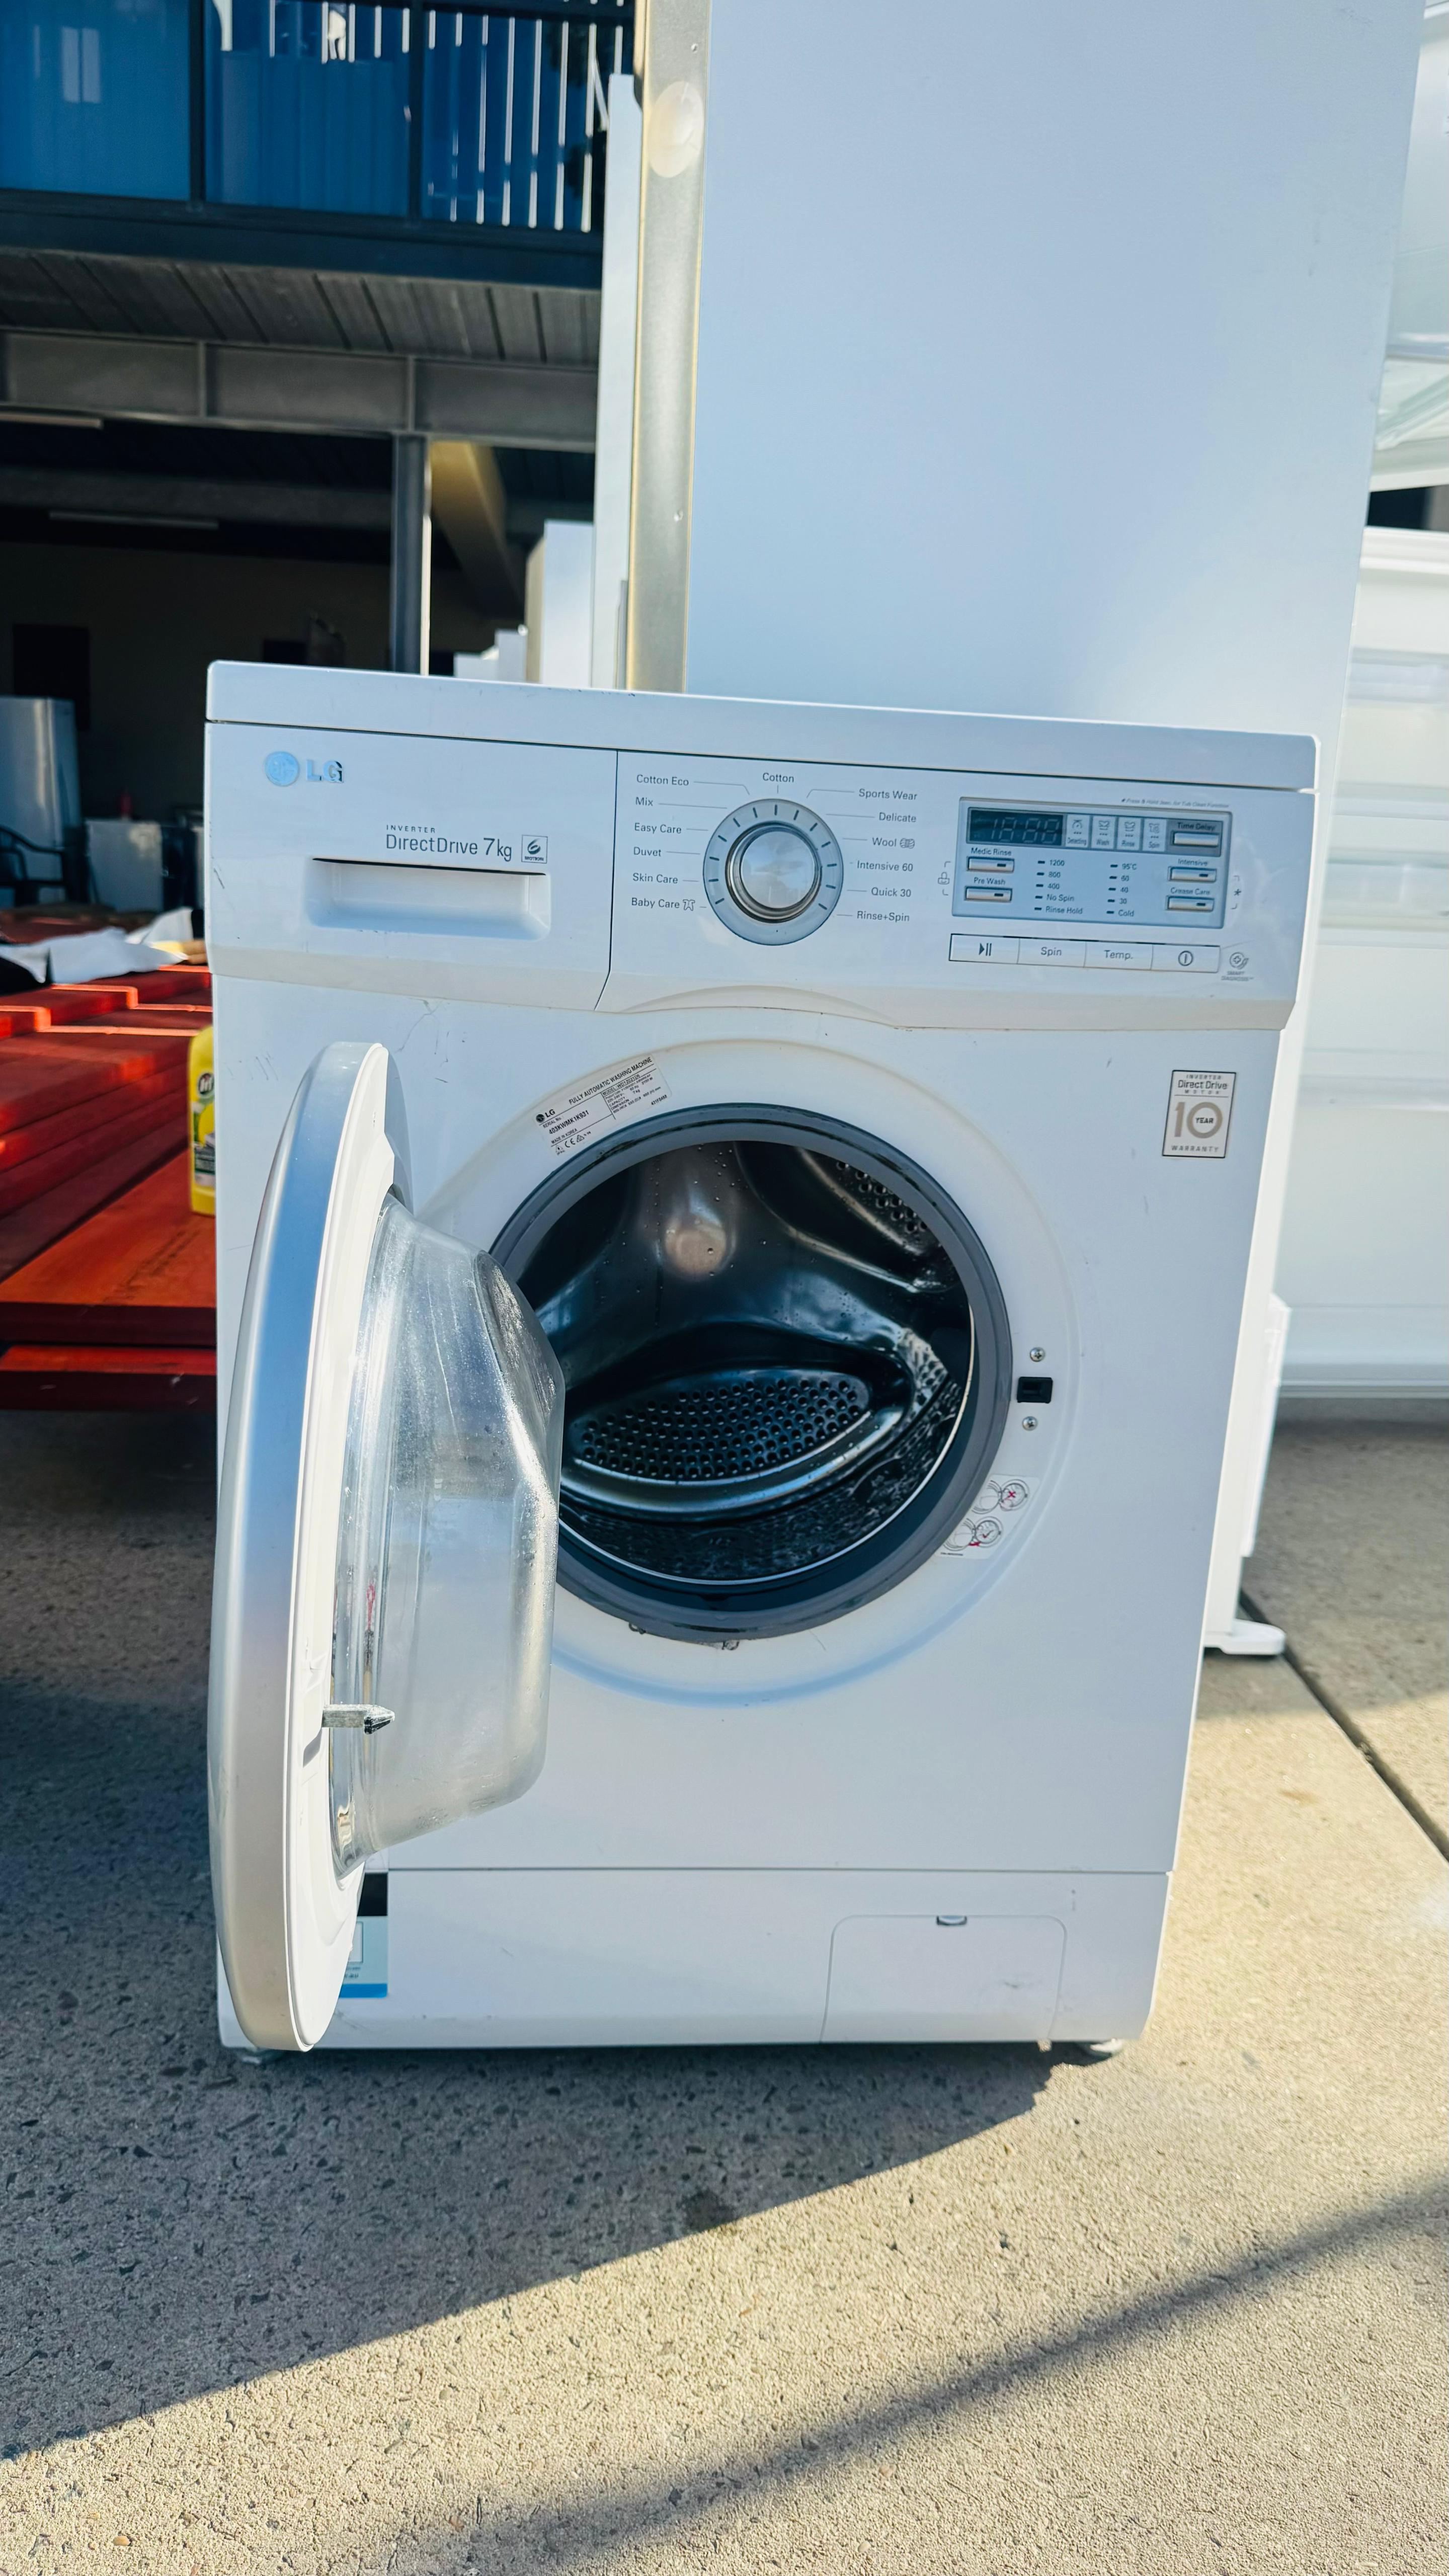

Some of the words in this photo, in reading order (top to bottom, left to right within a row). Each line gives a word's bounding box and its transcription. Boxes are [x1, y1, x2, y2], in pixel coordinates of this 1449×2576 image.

[306, 760, 343, 783] LG
[636, 775, 668, 785] Cotton
[672, 777, 689, 786] Eco
[763, 773, 794, 782] Cotton
[859, 789, 890, 800] Sports
[892, 791, 917, 800] Wear
[636, 797, 653, 806] Mix
[879, 813, 916, 823] Delicate
[634, 824, 656, 834] Easy
[660, 825, 682, 834] Care
[872, 838, 897, 847] Wool
[633, 847, 661, 857] Duvet
[857, 861, 900, 871] Intensive
[902, 863, 913, 871] 60
[633, 873, 653, 883] Skin
[656, 875, 678, 884] Care
[871, 887, 898, 898] Quick
[901, 889, 911, 897] 30
[631, 898, 655, 909] Baby
[658, 899, 680, 909] Care
[857, 911, 909, 922] Rinse+Spin
[1041, 947, 1062, 956] Spin
[1104, 949, 1133, 960] Temp.
[569, 1093, 584, 1105] FULLY
[583, 1079, 611, 1097] AUTOMATIC
[609, 1068, 632, 1083] WASHING
[631, 1057, 653, 1071] MACHINE
[1178, 1080, 1203, 1089] Direct
[1205, 1081, 1228, 1089] Drive
[545, 1109, 555, 1118] LG
